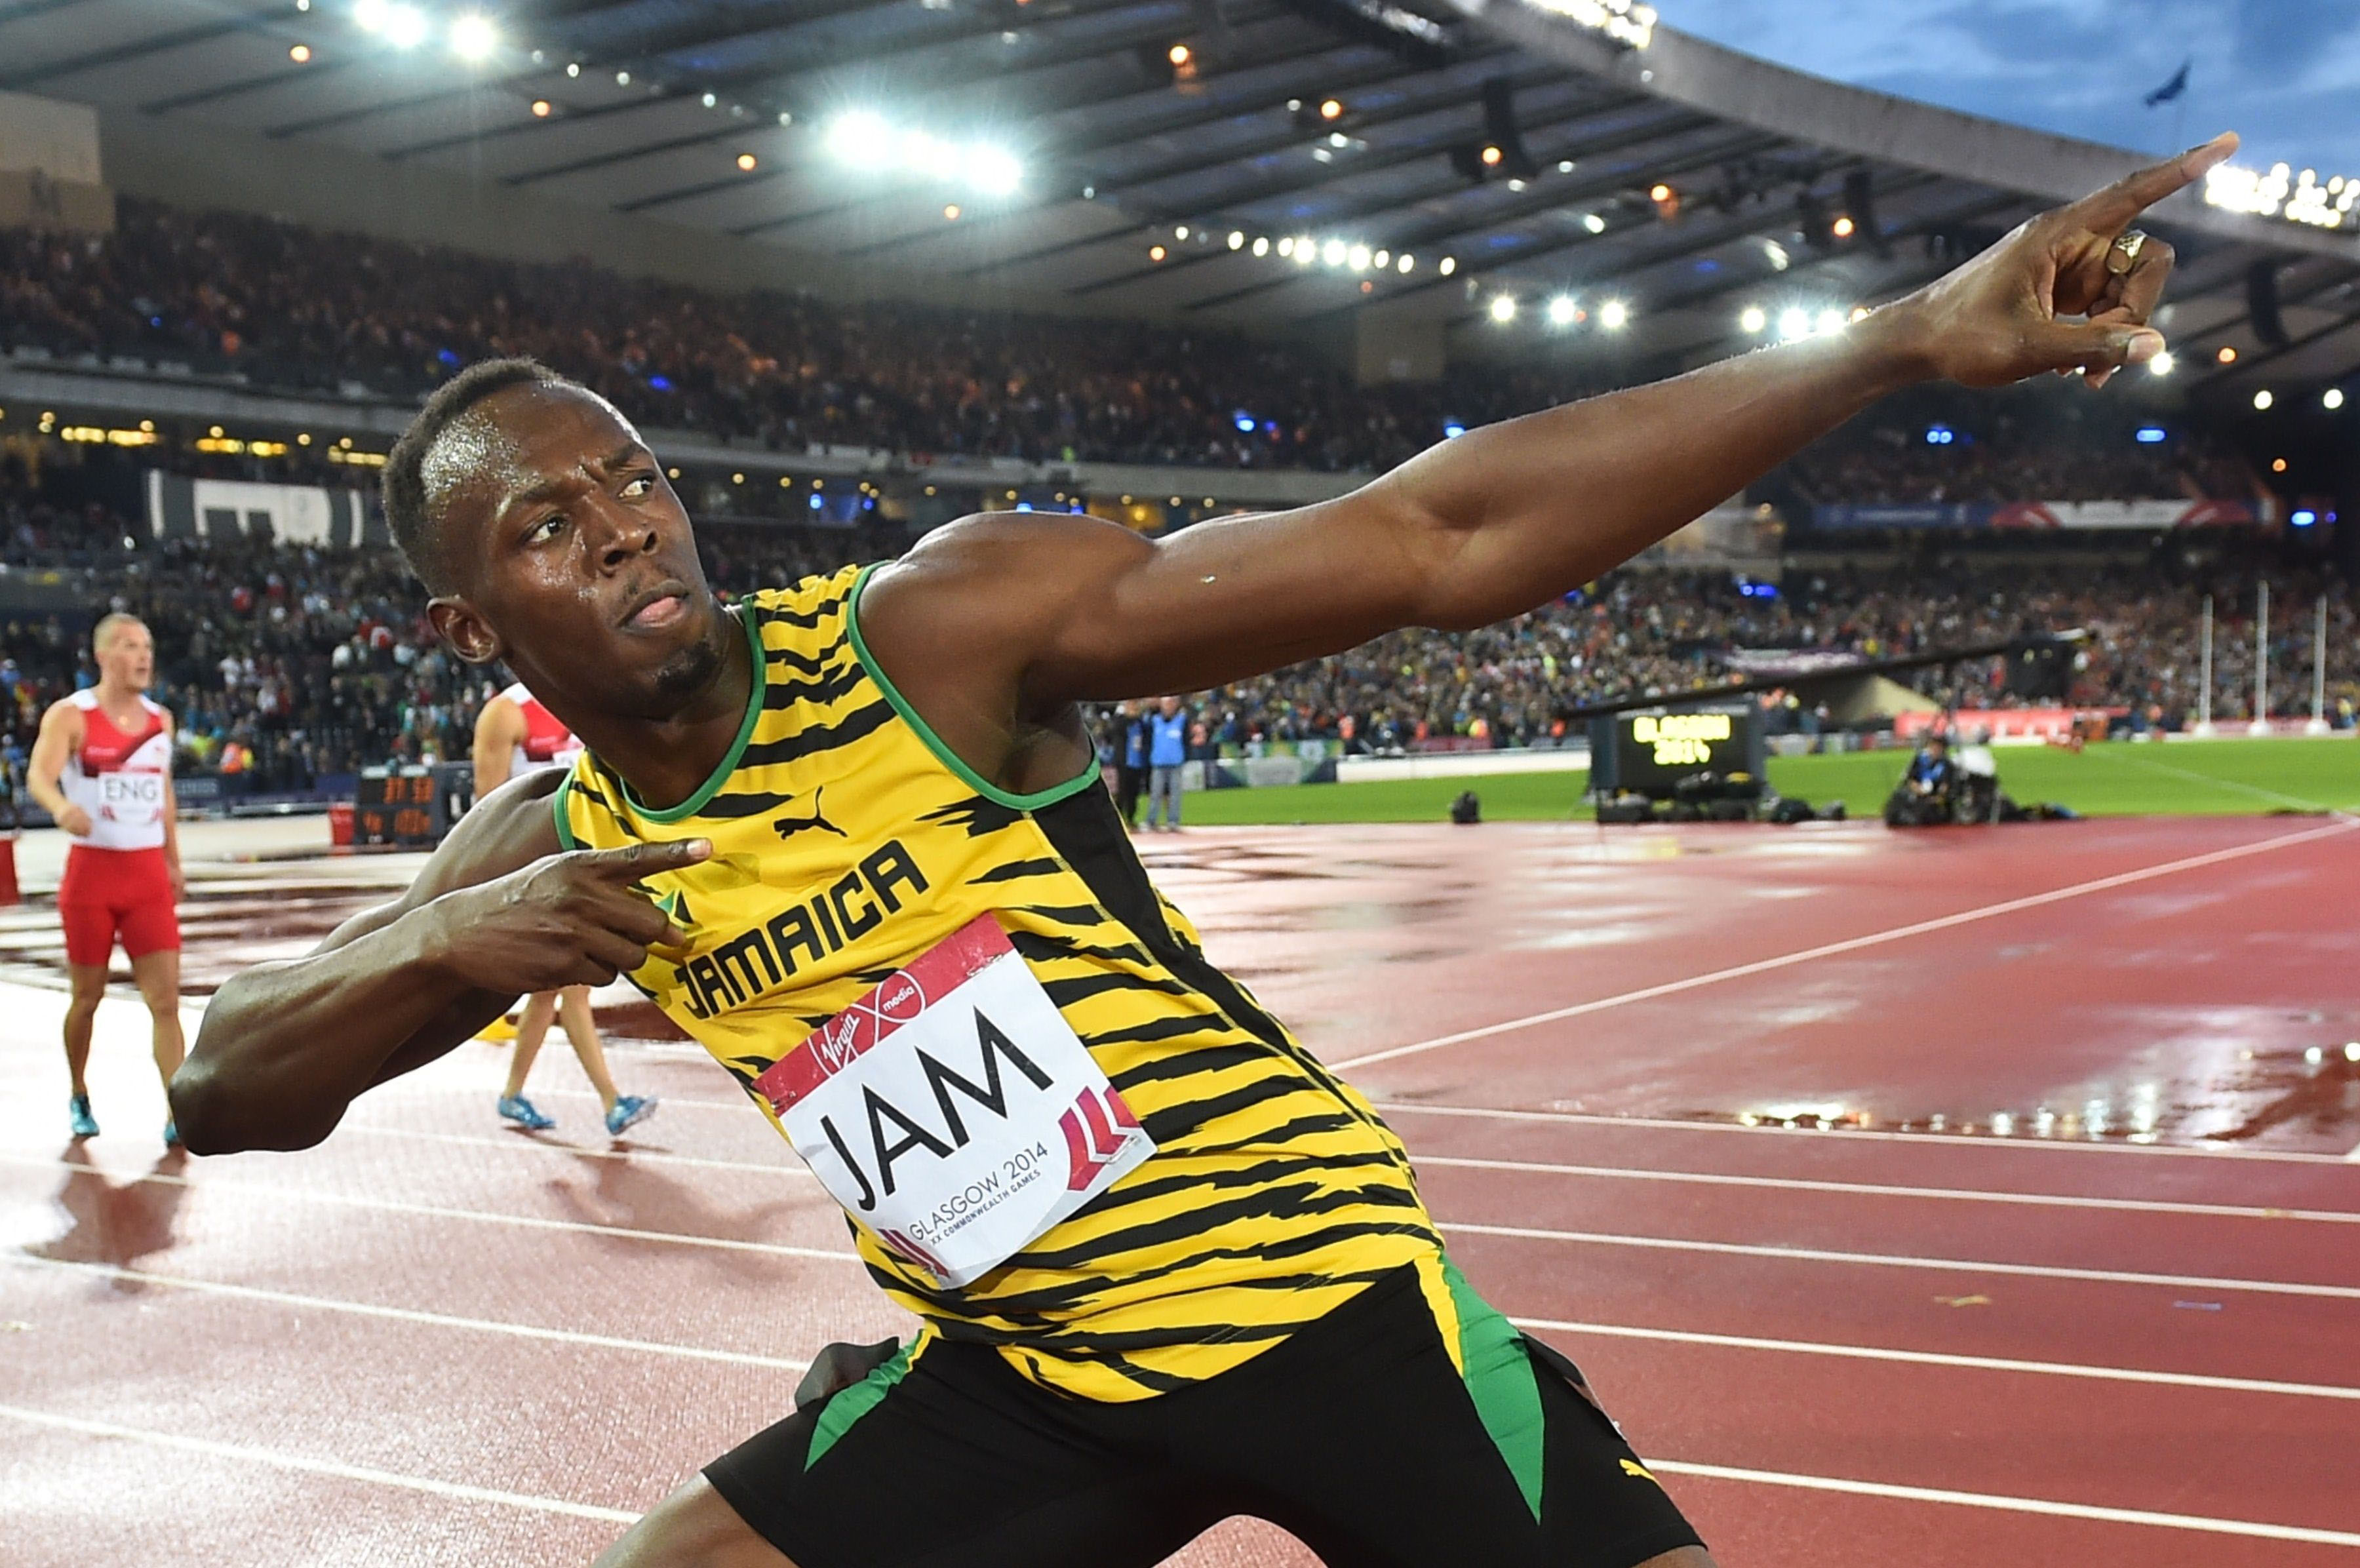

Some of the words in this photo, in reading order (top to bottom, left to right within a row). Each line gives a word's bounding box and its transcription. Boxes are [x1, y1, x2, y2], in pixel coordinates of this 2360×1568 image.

[105, 777, 159, 800] ENG
[674, 839, 930, 1020] JAMAICA
[821, 1013, 860, 1069] Virgin
[882, 985, 915, 1011] media
[820, 1004, 1055, 1211] JAM
[909, 1171, 1000, 1240] GLASGOW
[1003, 1141, 1048, 1179] 2014
[931, 1234, 942, 1245] XX
[943, 1190, 1010, 1238] COMMONWEALTH
[1010, 1168, 1042, 1193] GAMES
